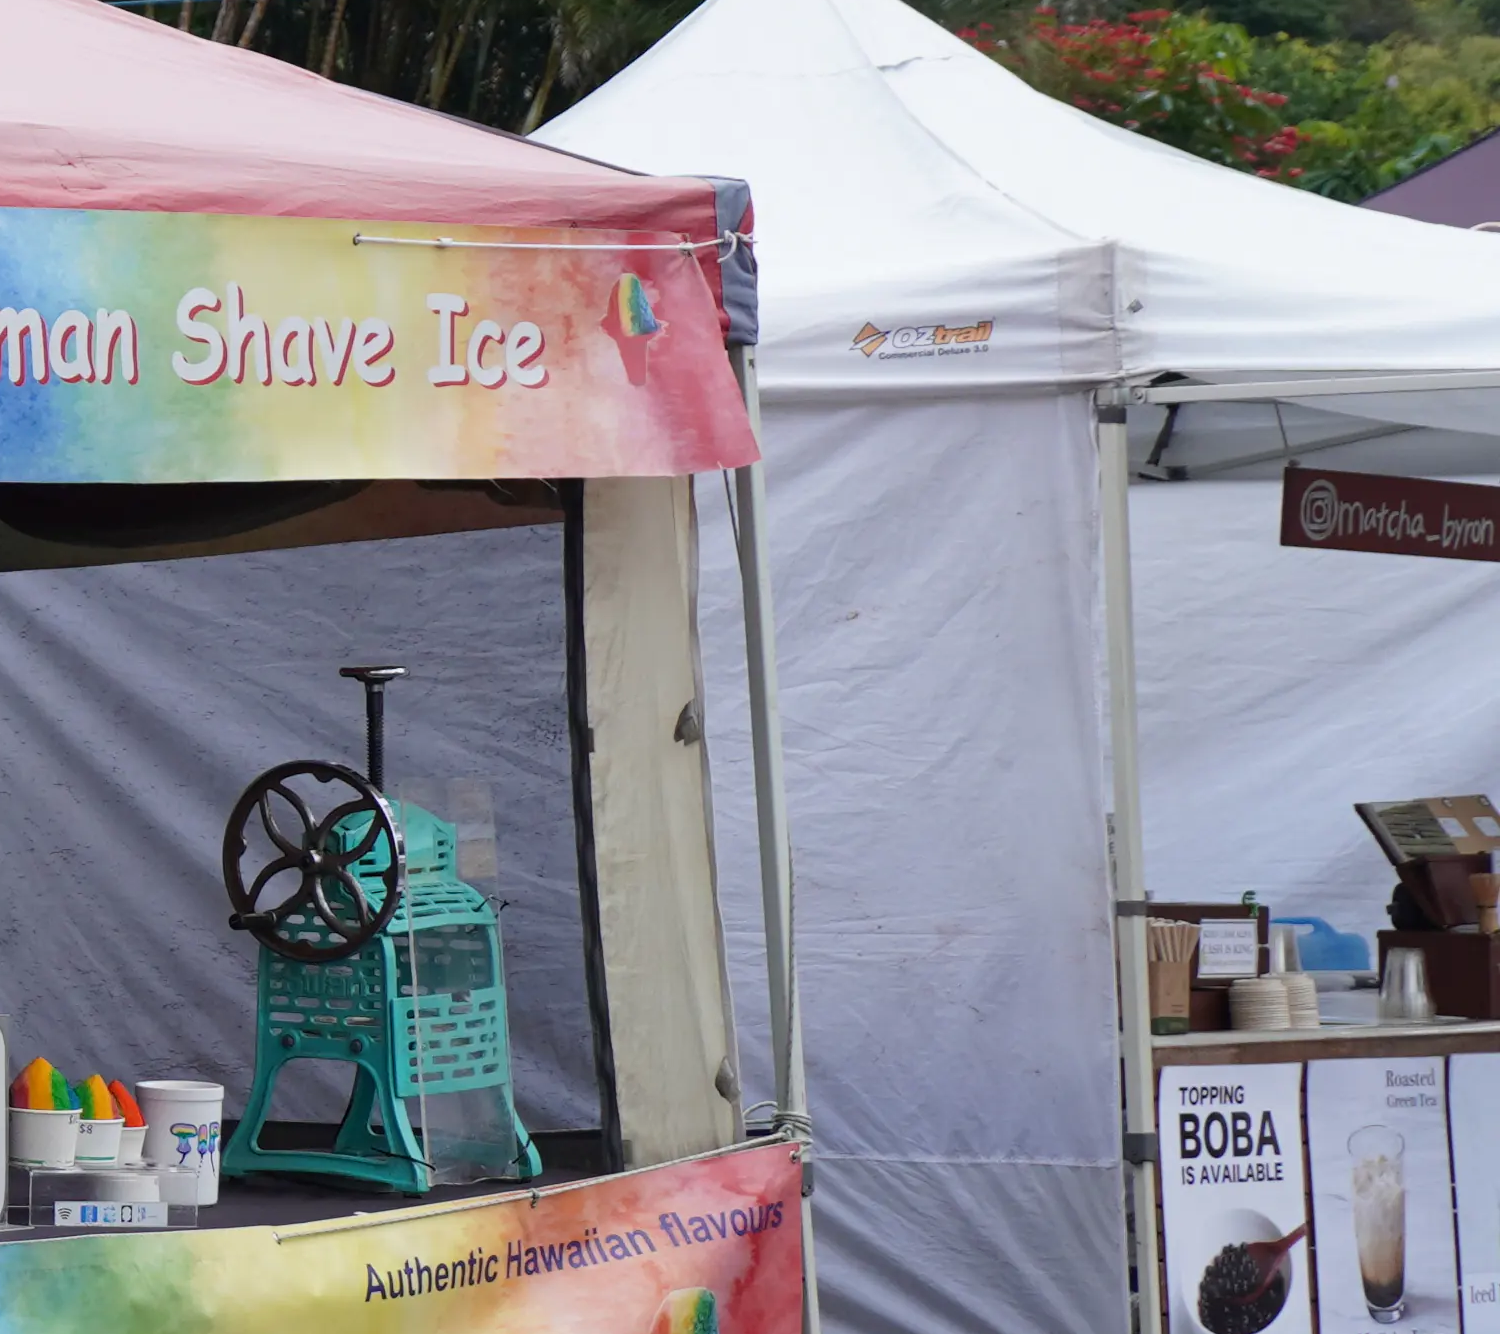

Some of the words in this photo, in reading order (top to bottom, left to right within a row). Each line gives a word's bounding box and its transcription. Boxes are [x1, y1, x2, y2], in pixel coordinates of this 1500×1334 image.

[170, 282, 397, 389] Shave
[424, 292, 547, 389] Ice
[1385, 1069, 1436, 1087] Roasted
[1179, 1085, 1244, 1106] TOPPING
[1386, 1095, 1416, 1108] Green
[1418, 1094, 1437, 1107] Tea
[1179, 1110, 1281, 1160] BOBA
[1182, 1166, 1195, 1185] IS
[1200, 1163, 1284, 1184] AVAILABLE
[362, 1245, 497, 1307] Authentic
[502, 1221, 655, 1281] Hawaiian
[660, 1197, 786, 1253] flavours
